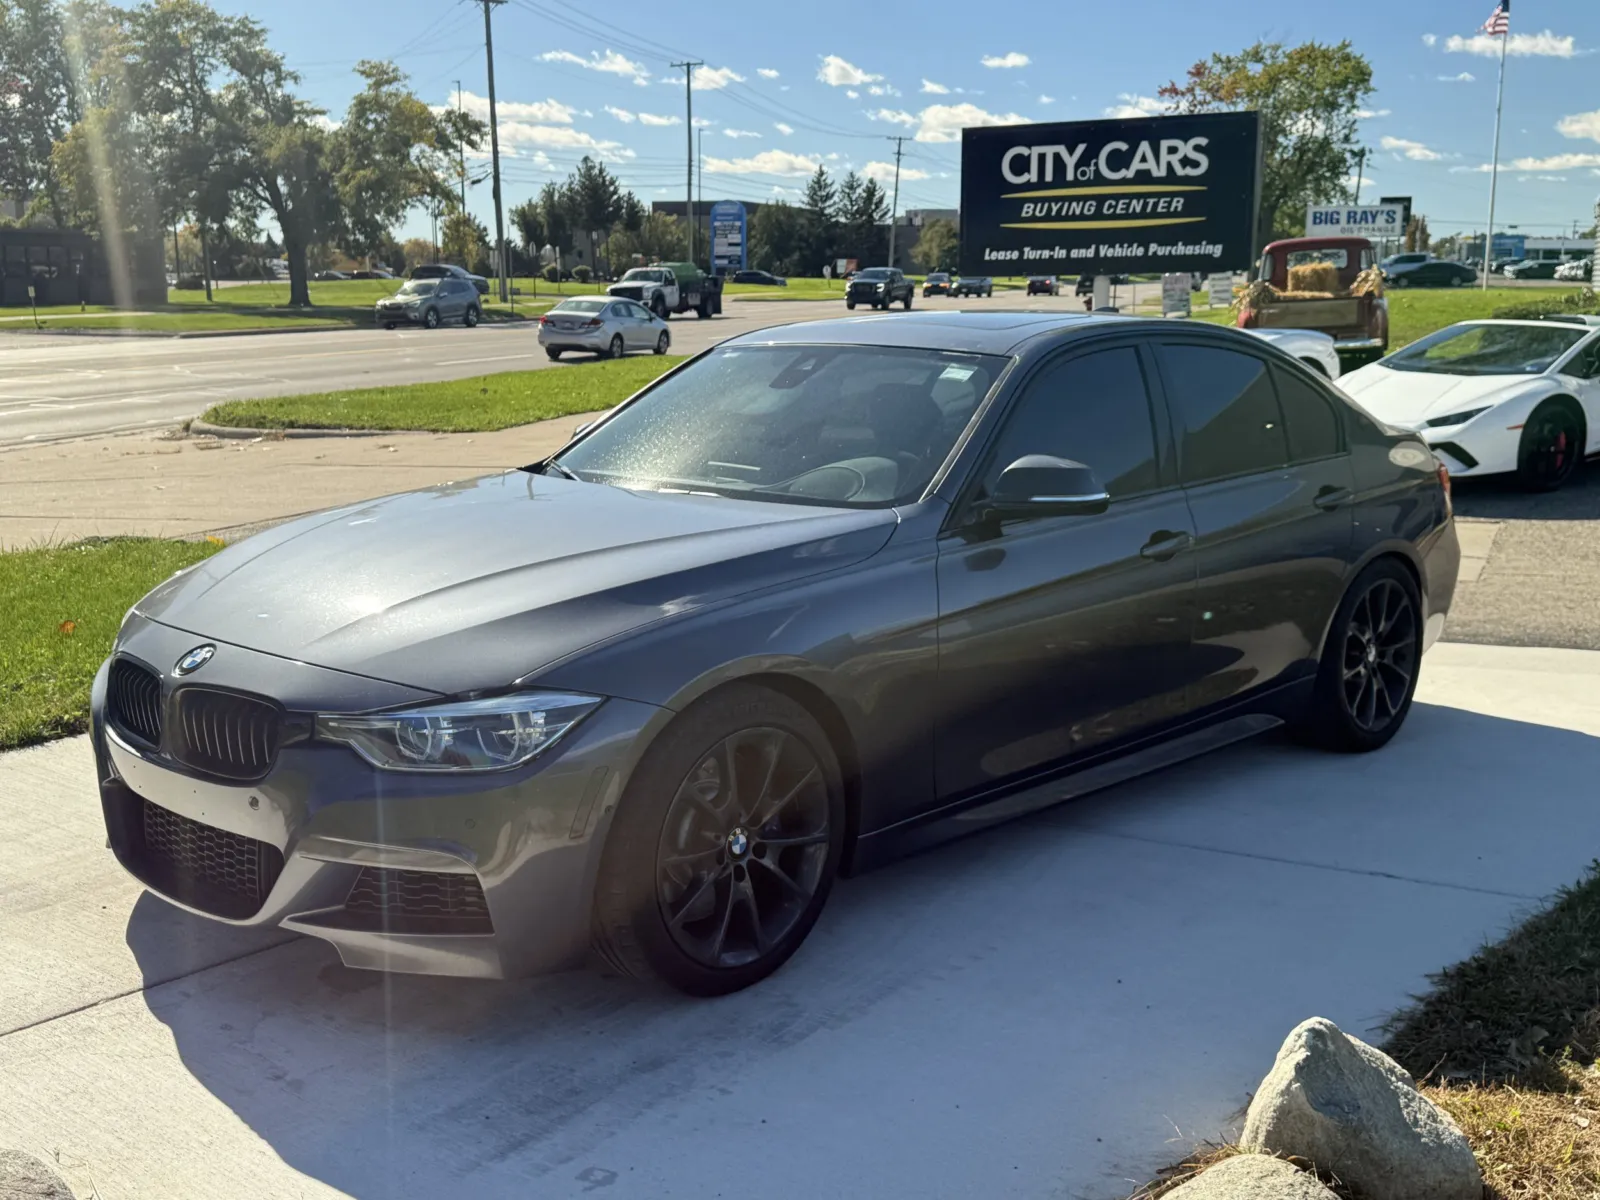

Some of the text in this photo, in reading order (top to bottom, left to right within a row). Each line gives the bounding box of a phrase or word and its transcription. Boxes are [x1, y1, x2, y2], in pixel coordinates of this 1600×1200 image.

[1001, 136, 1209, 184] CITY of CARS
[1021, 197, 1185, 217] BUYING CENTER
[1312, 209, 1397, 225] BIG RAY'S
[984, 240, 1223, 260] Lease Turn-In and Vehicle Purchasing
